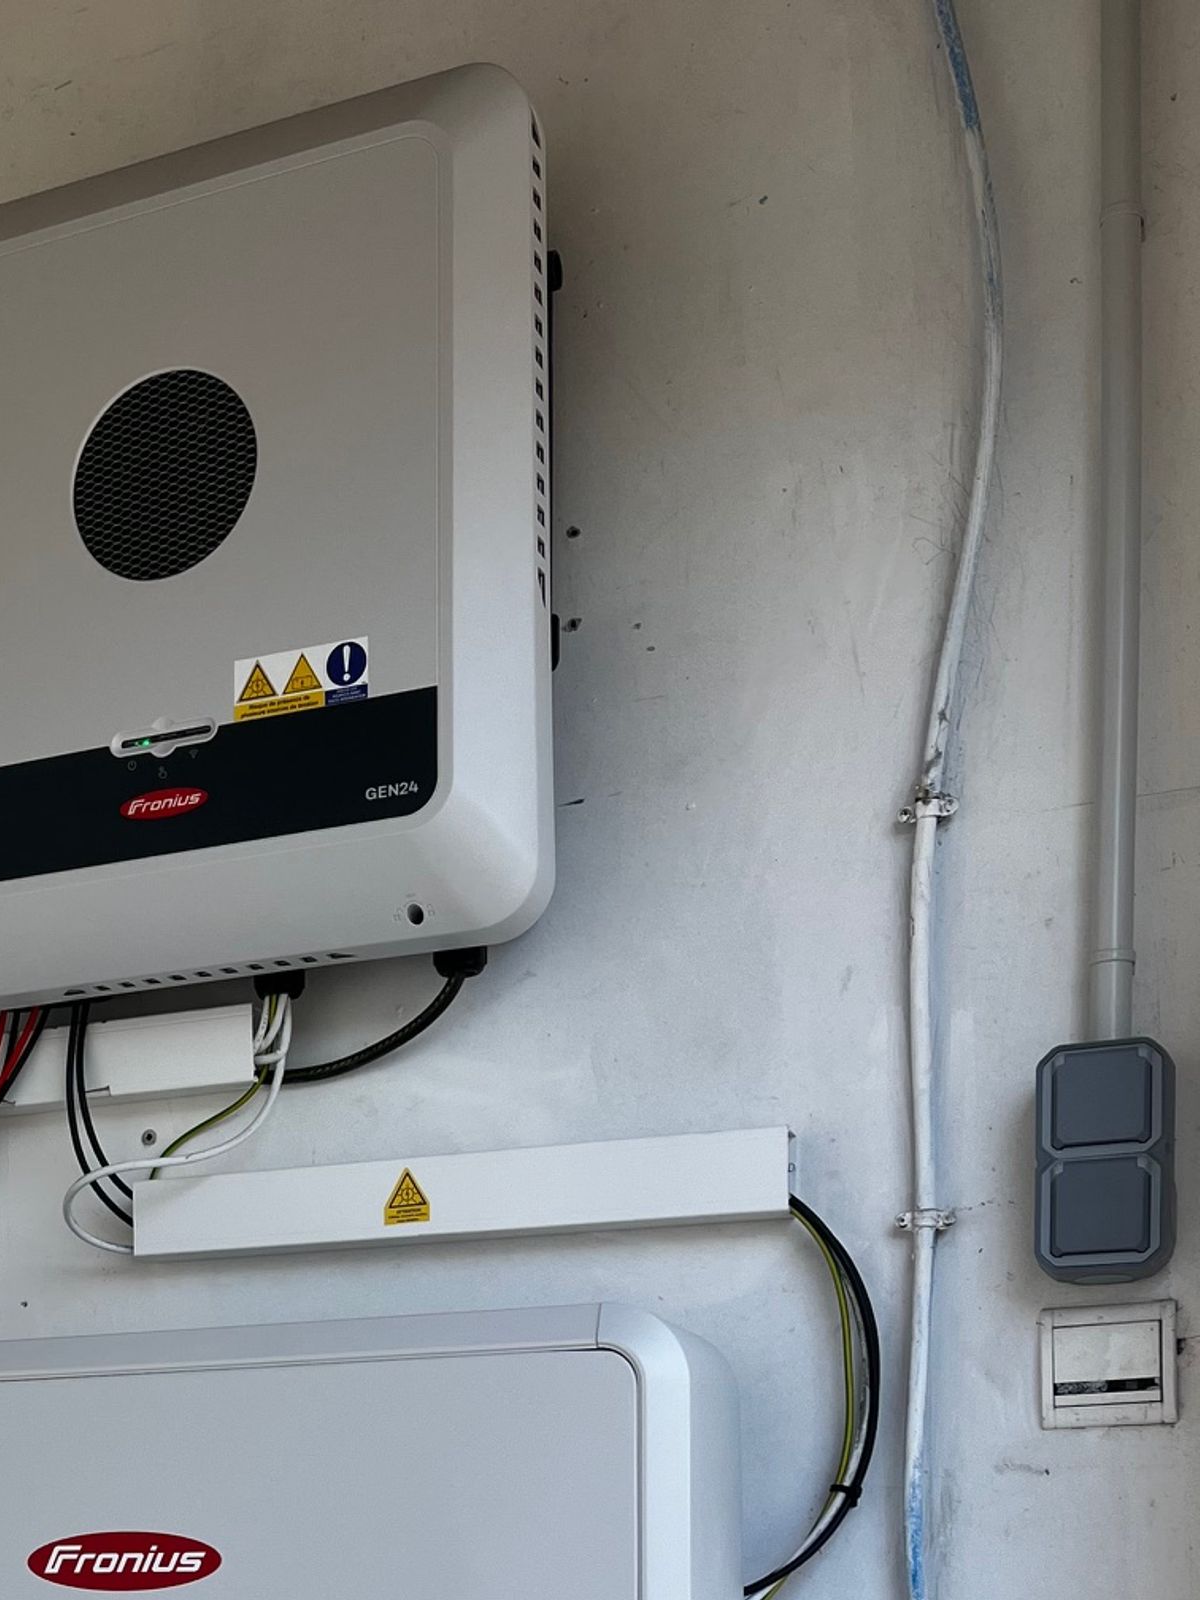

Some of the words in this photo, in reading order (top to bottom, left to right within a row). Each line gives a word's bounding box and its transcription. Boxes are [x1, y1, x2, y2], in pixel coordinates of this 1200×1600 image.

[365, 781, 418, 800] GEN24
[127, 793, 201, 815] Fronius
[44, 1545, 206, 1573] Fronius
